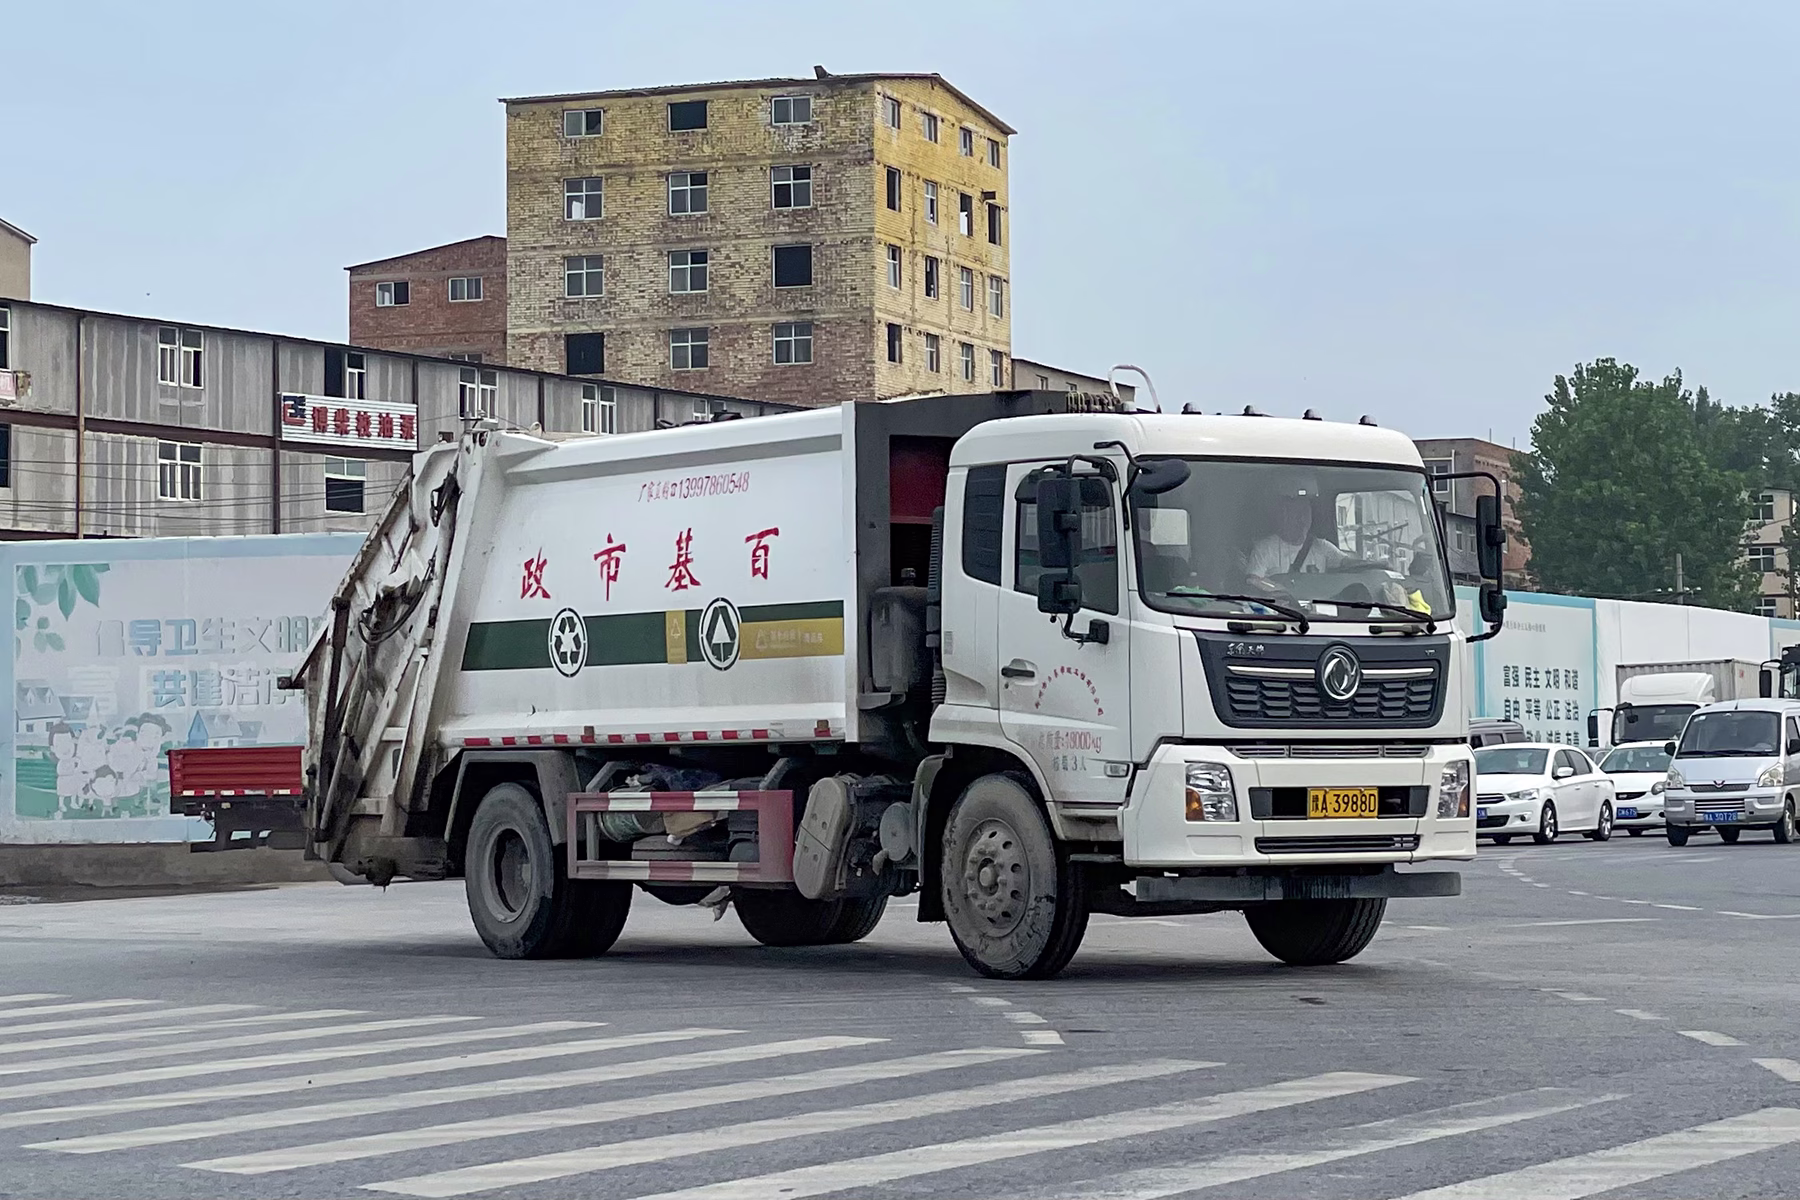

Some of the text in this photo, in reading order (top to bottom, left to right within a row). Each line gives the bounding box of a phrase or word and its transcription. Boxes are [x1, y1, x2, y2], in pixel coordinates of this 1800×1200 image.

[1525, 666, 1541, 689] 民主
[1545, 667, 1560, 690] 文明
[1525, 698, 1541, 721] 平等
[1546, 699, 1560, 720] 公正
